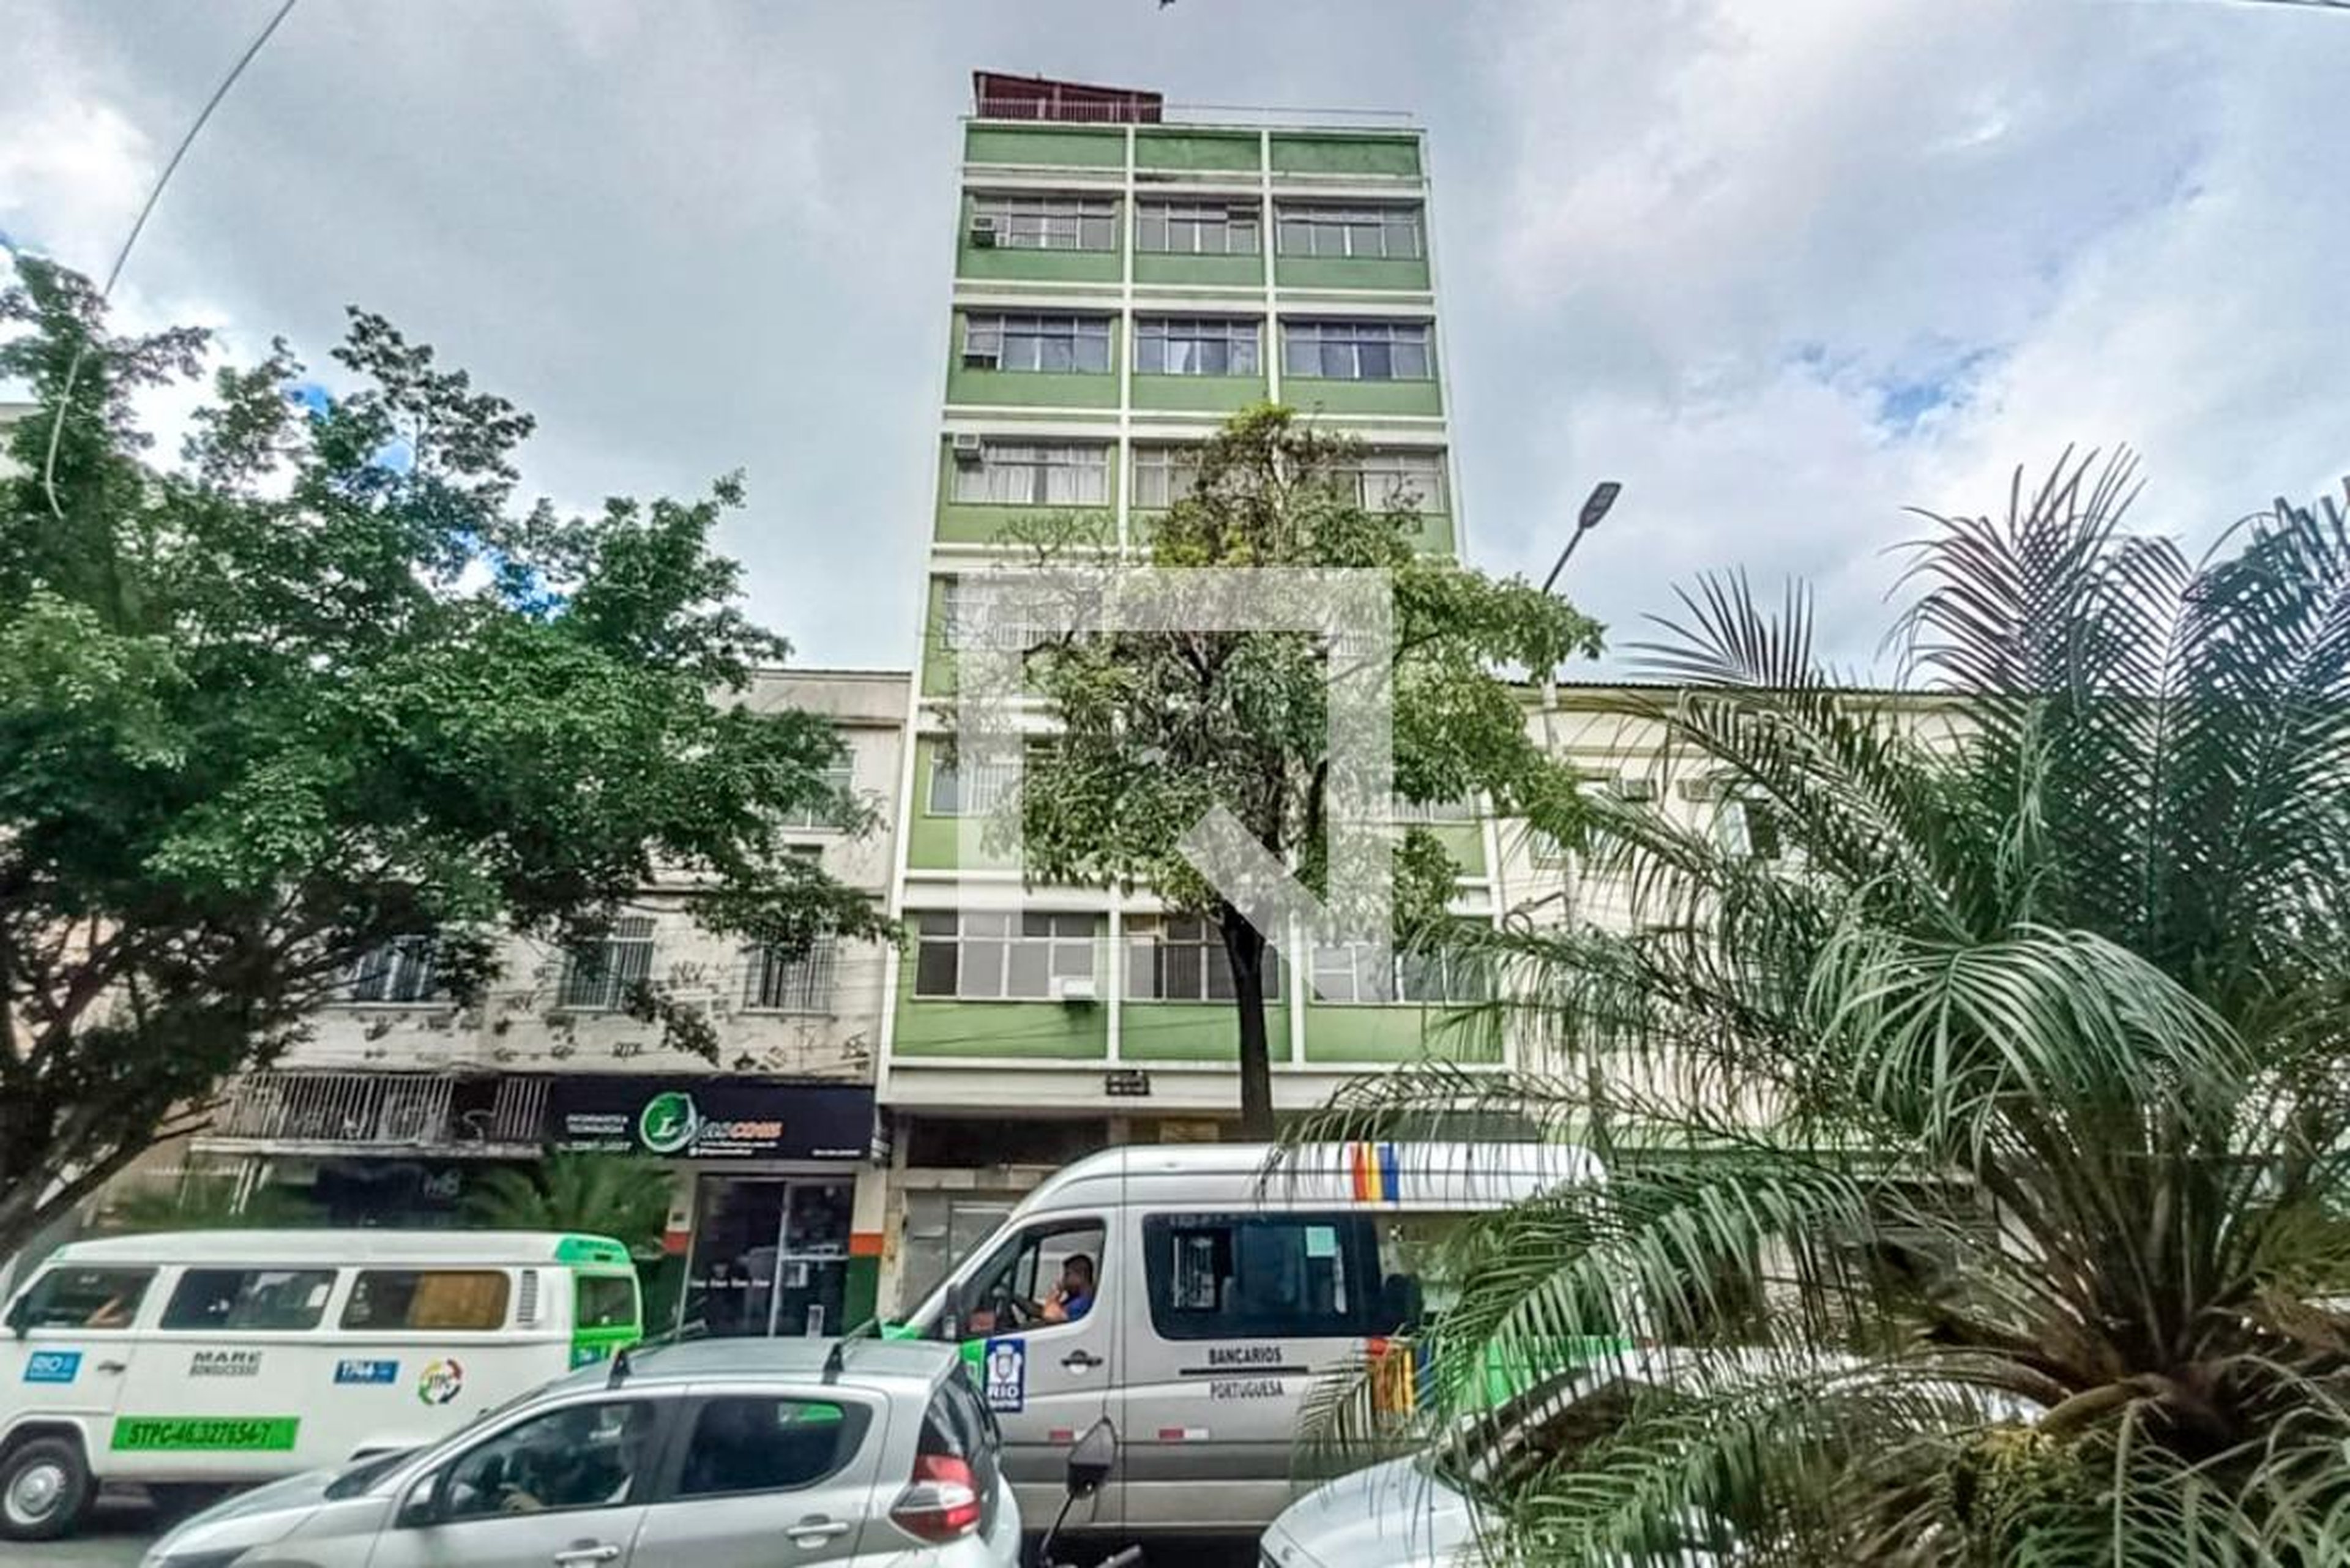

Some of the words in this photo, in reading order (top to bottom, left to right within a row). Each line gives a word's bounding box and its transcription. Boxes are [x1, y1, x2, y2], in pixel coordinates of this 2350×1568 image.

[1209, 1347, 1281, 1365] BANCARIOS
[987, 1384, 1019, 1398] RIO
[1210, 1380, 1284, 1400] PORTUGUESA
